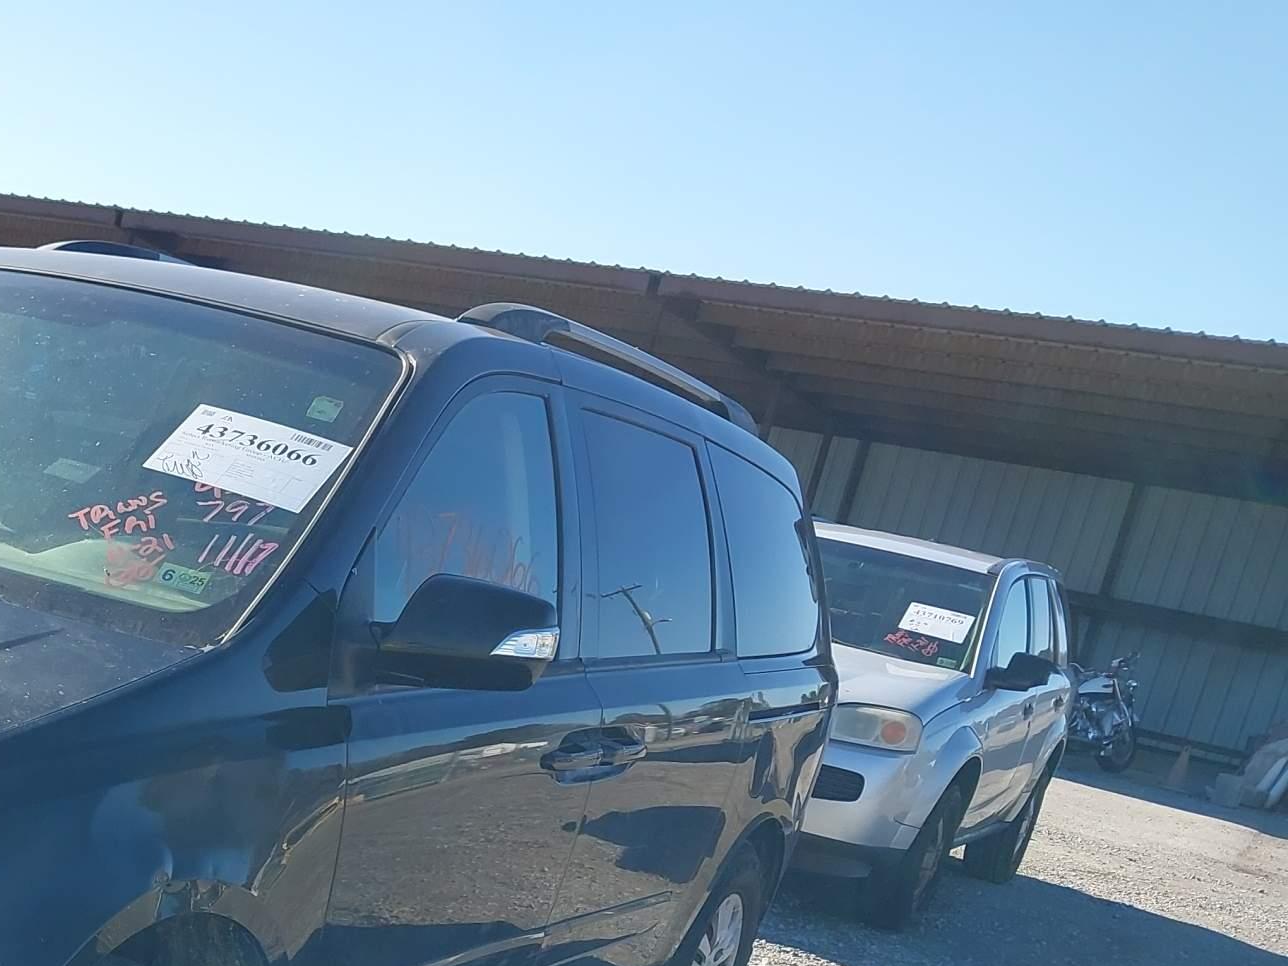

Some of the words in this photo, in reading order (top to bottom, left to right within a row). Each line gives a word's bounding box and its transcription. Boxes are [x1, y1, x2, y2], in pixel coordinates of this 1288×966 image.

[196, 422, 323, 467] 43736066
[196, 500, 275, 526] 797
[162, 569, 176, 581] 6
[190, 575, 207, 586] 25
